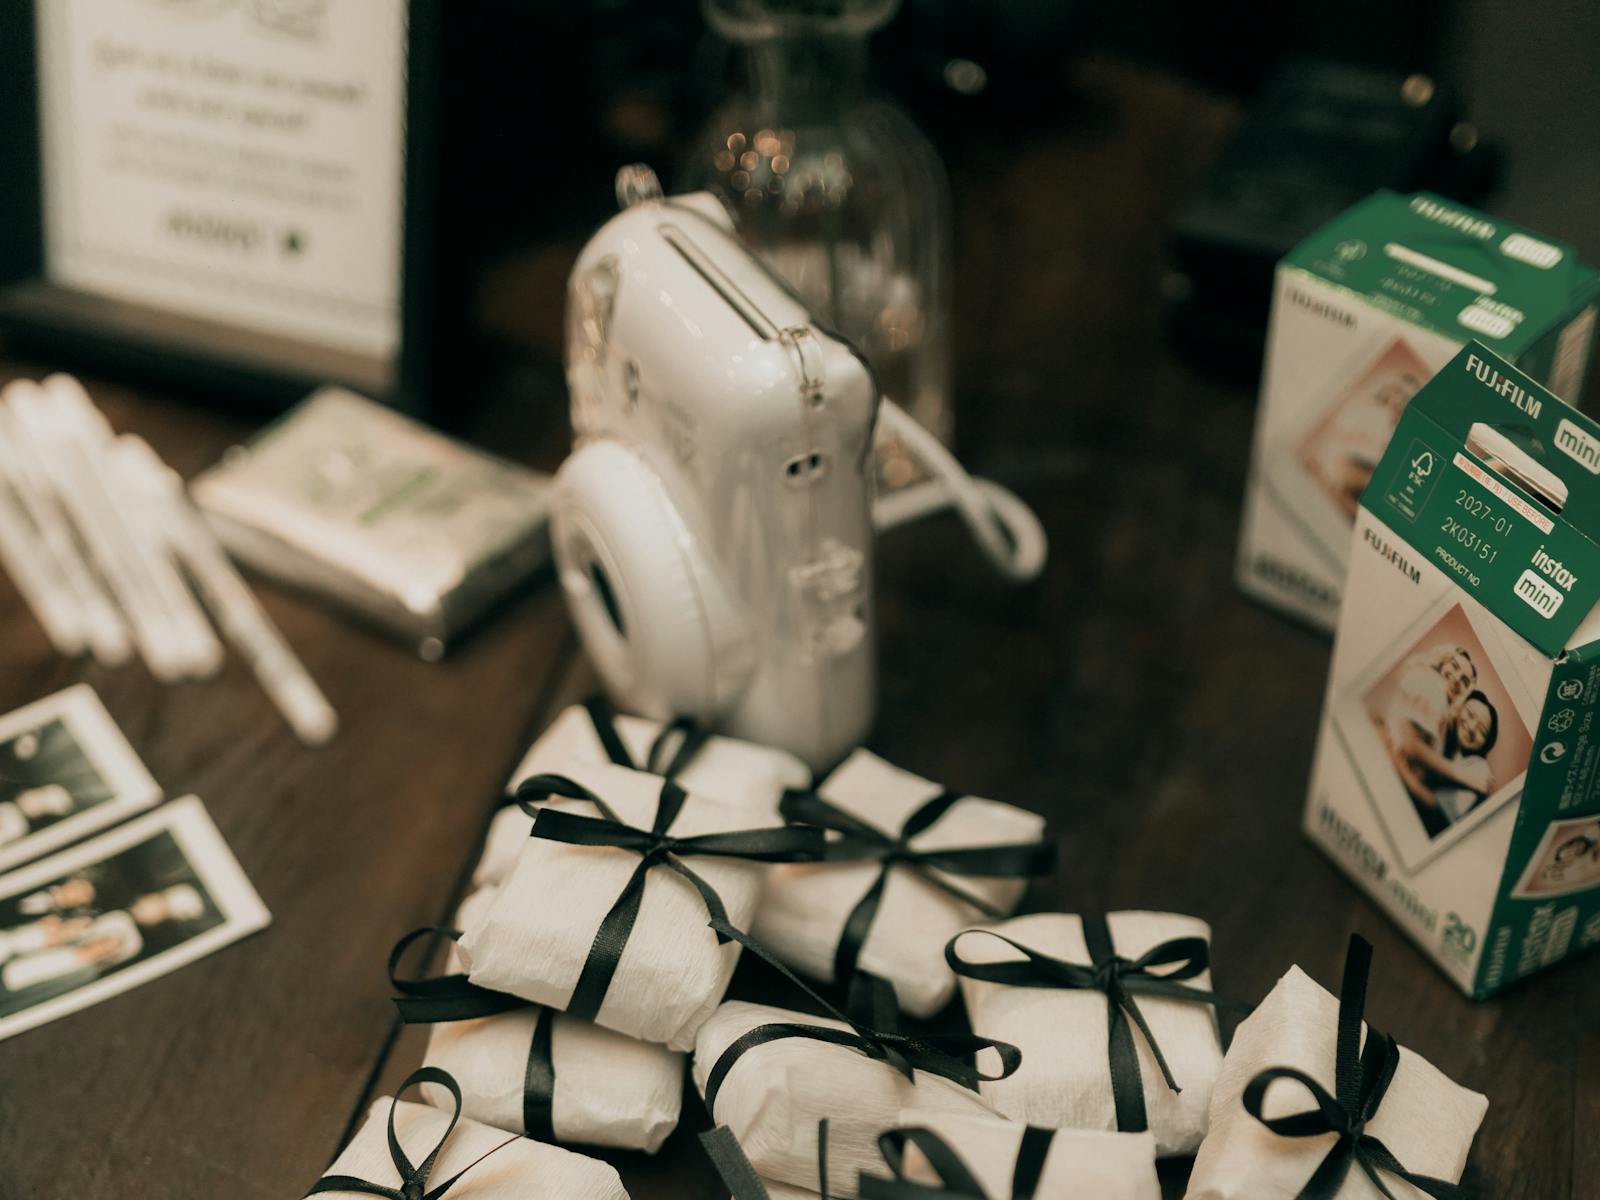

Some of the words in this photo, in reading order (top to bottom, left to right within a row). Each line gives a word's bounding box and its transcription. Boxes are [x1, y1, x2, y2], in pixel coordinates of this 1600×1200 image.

[1465, 353, 1543, 420] FUJIFILM
[1559, 426, 1600, 469] mini
[1455, 489, 1513, 537] 2027-01
[1364, 528, 1421, 585] FUJIFILM
[1435, 546, 1470, 577] PRODUCT
[1441, 516, 1498, 564] 2K03151
[1530, 544, 1578, 592] instax
[1518, 577, 1559, 613] mini
[1441, 911, 1476, 954] 20
